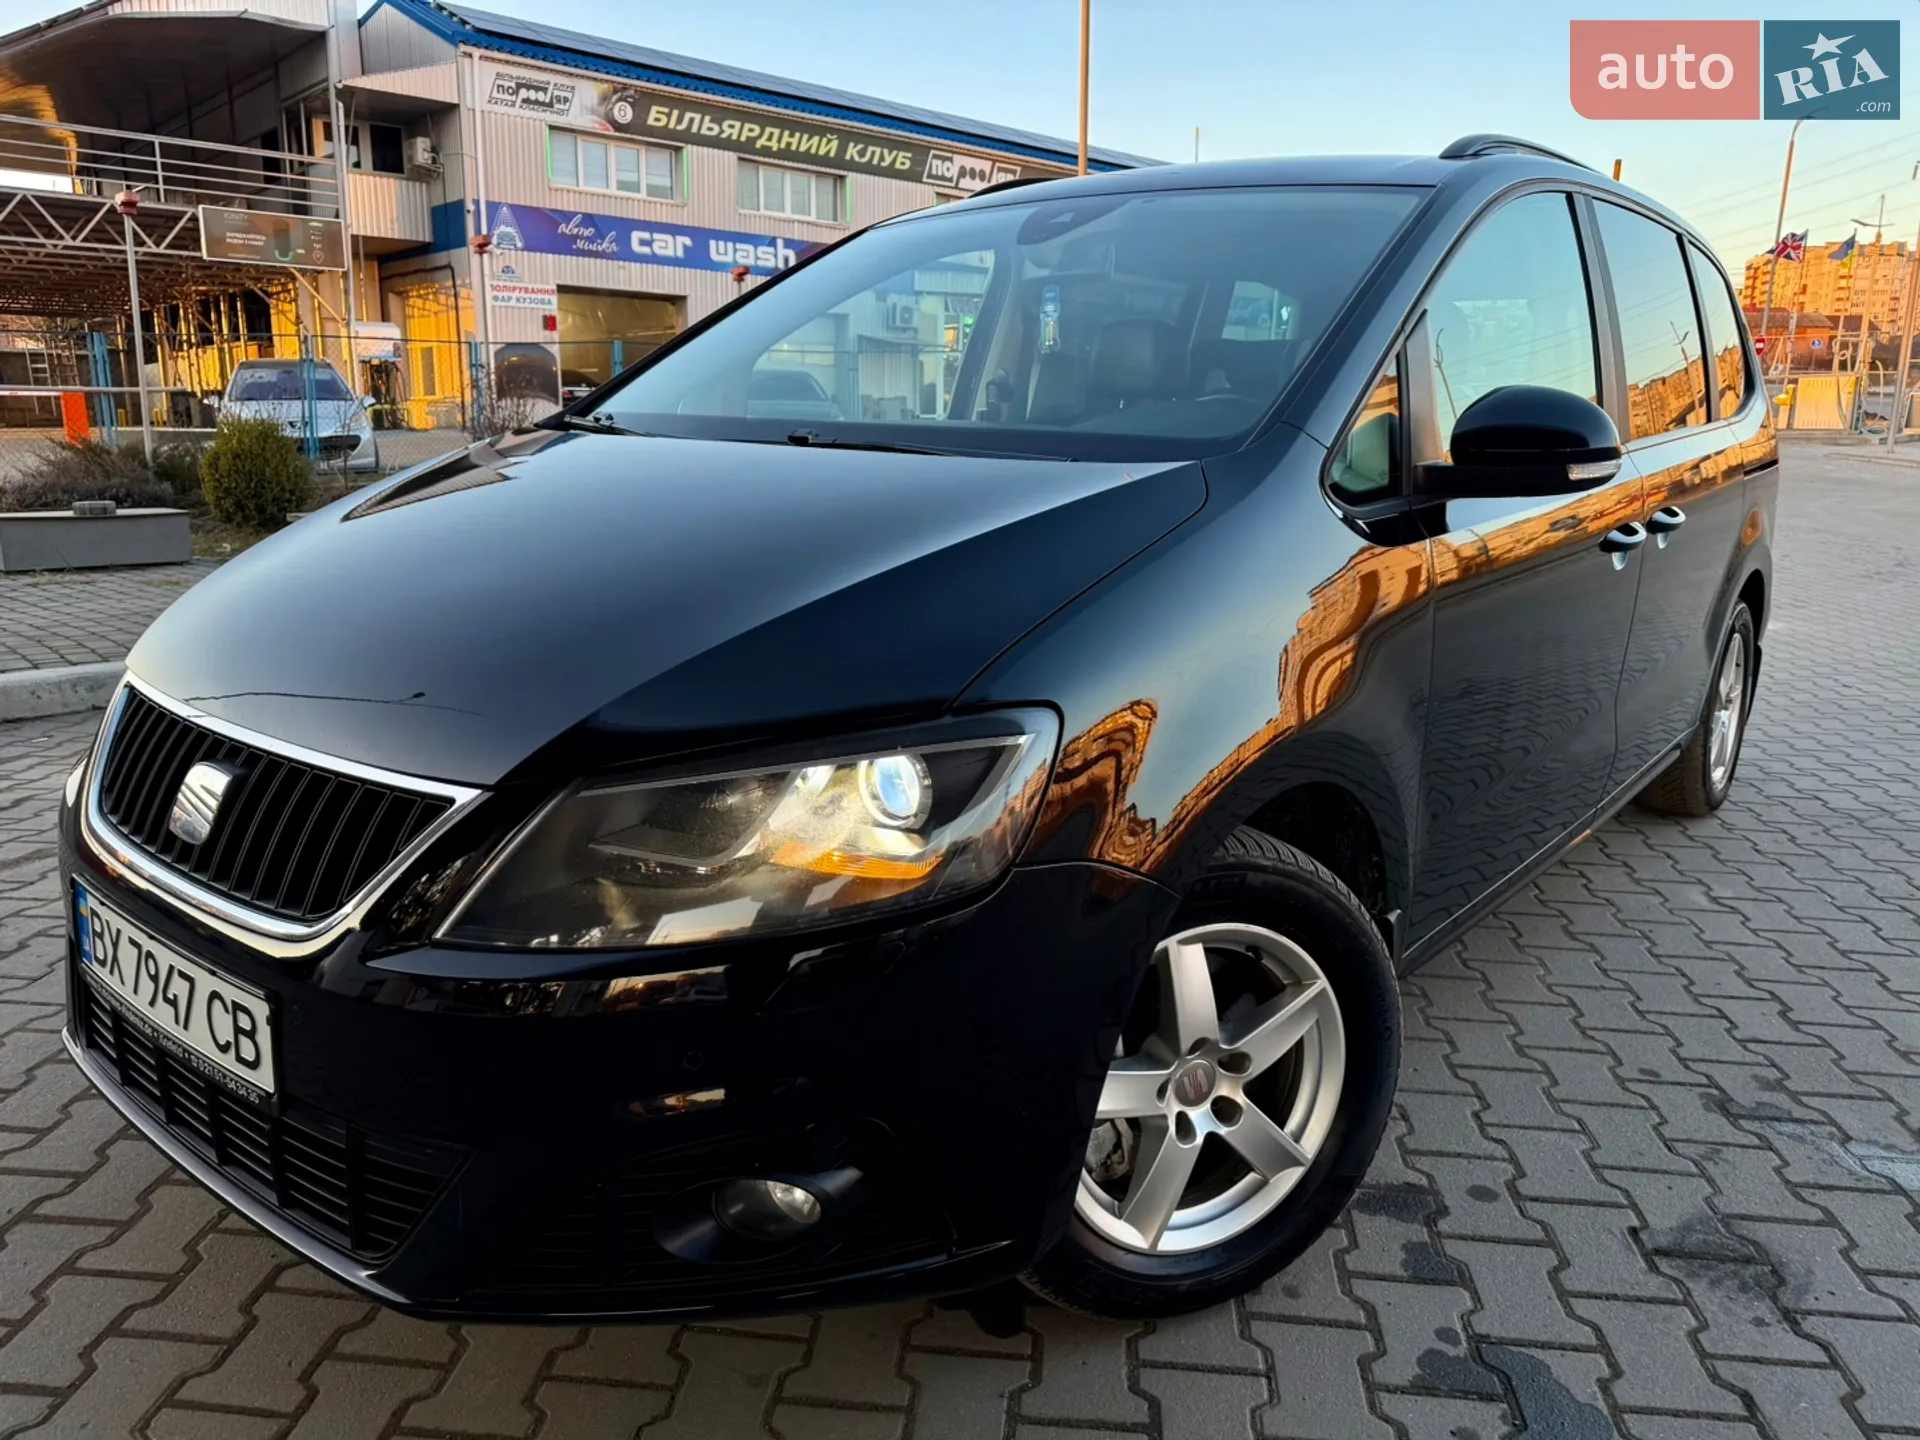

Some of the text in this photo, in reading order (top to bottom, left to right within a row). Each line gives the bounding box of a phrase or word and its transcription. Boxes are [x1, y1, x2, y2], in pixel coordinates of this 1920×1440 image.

[495, 71, 576, 91] БІЛЬЯРДНИЙ КЛУБ
[646, 104, 913, 170] БІЛЬЯРДНИЙ КЛУБ
[558, 213, 596, 238] авто
[572, 231, 621, 253] мийка
[630, 230, 797, 271] car wash
[492, 295, 552, 305] ФАР КУЗОВА
[90, 905, 126, 985] BX
[128, 936, 196, 1032] 7947
[207, 990, 262, 1071] CB
